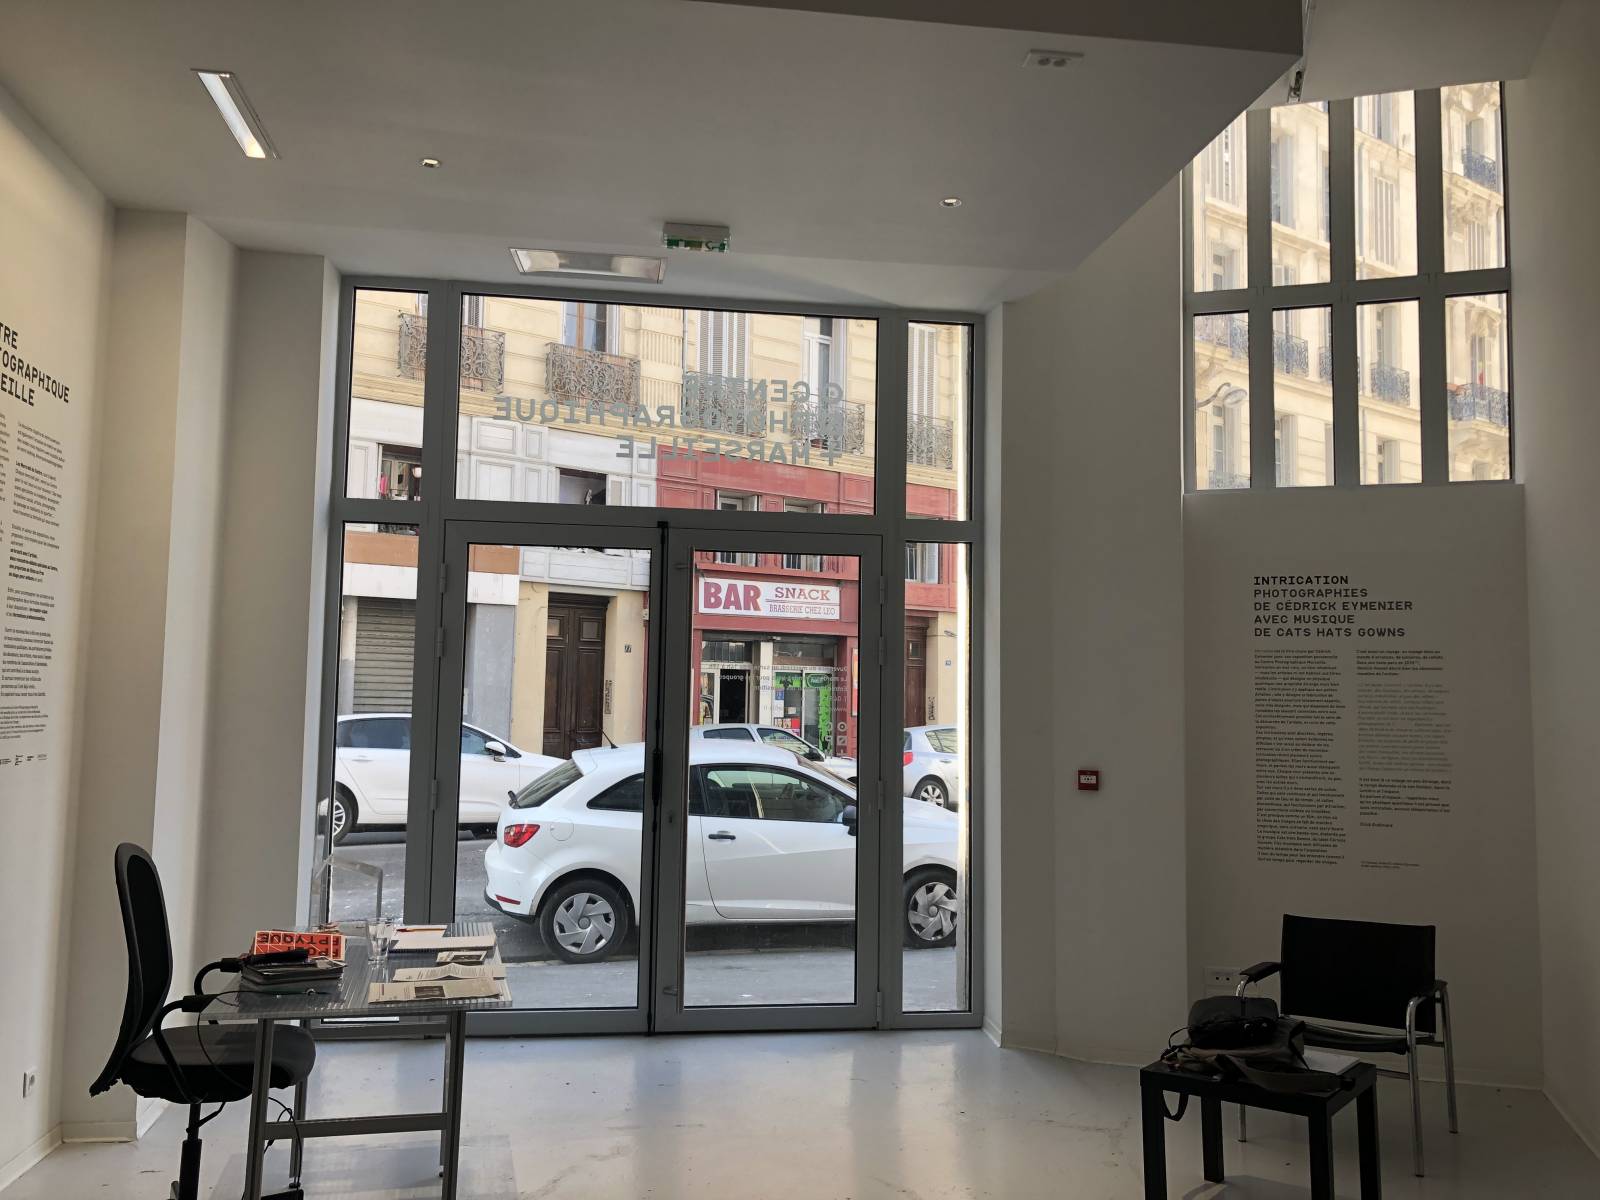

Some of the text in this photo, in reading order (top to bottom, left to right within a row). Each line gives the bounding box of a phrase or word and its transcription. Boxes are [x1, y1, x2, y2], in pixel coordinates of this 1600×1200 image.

[0, 347, 70, 403] OGRAPHIQUE
[1254, 576, 1348, 585] INTRICATION
[704, 581, 831, 611] BAR SNACK
[1254, 588, 1368, 598] PHOTOGRAPHIES
[769, 603, 803, 614] BRASSERIE
[804, 605, 821, 615] CHEZ
[1254, 600, 1413, 611] DE CÉDRICK EYMENIER
[1255, 614, 1355, 625] AVEC MUSIQUE
[1255, 627, 1406, 638] DE CATS HATS GOWNS
